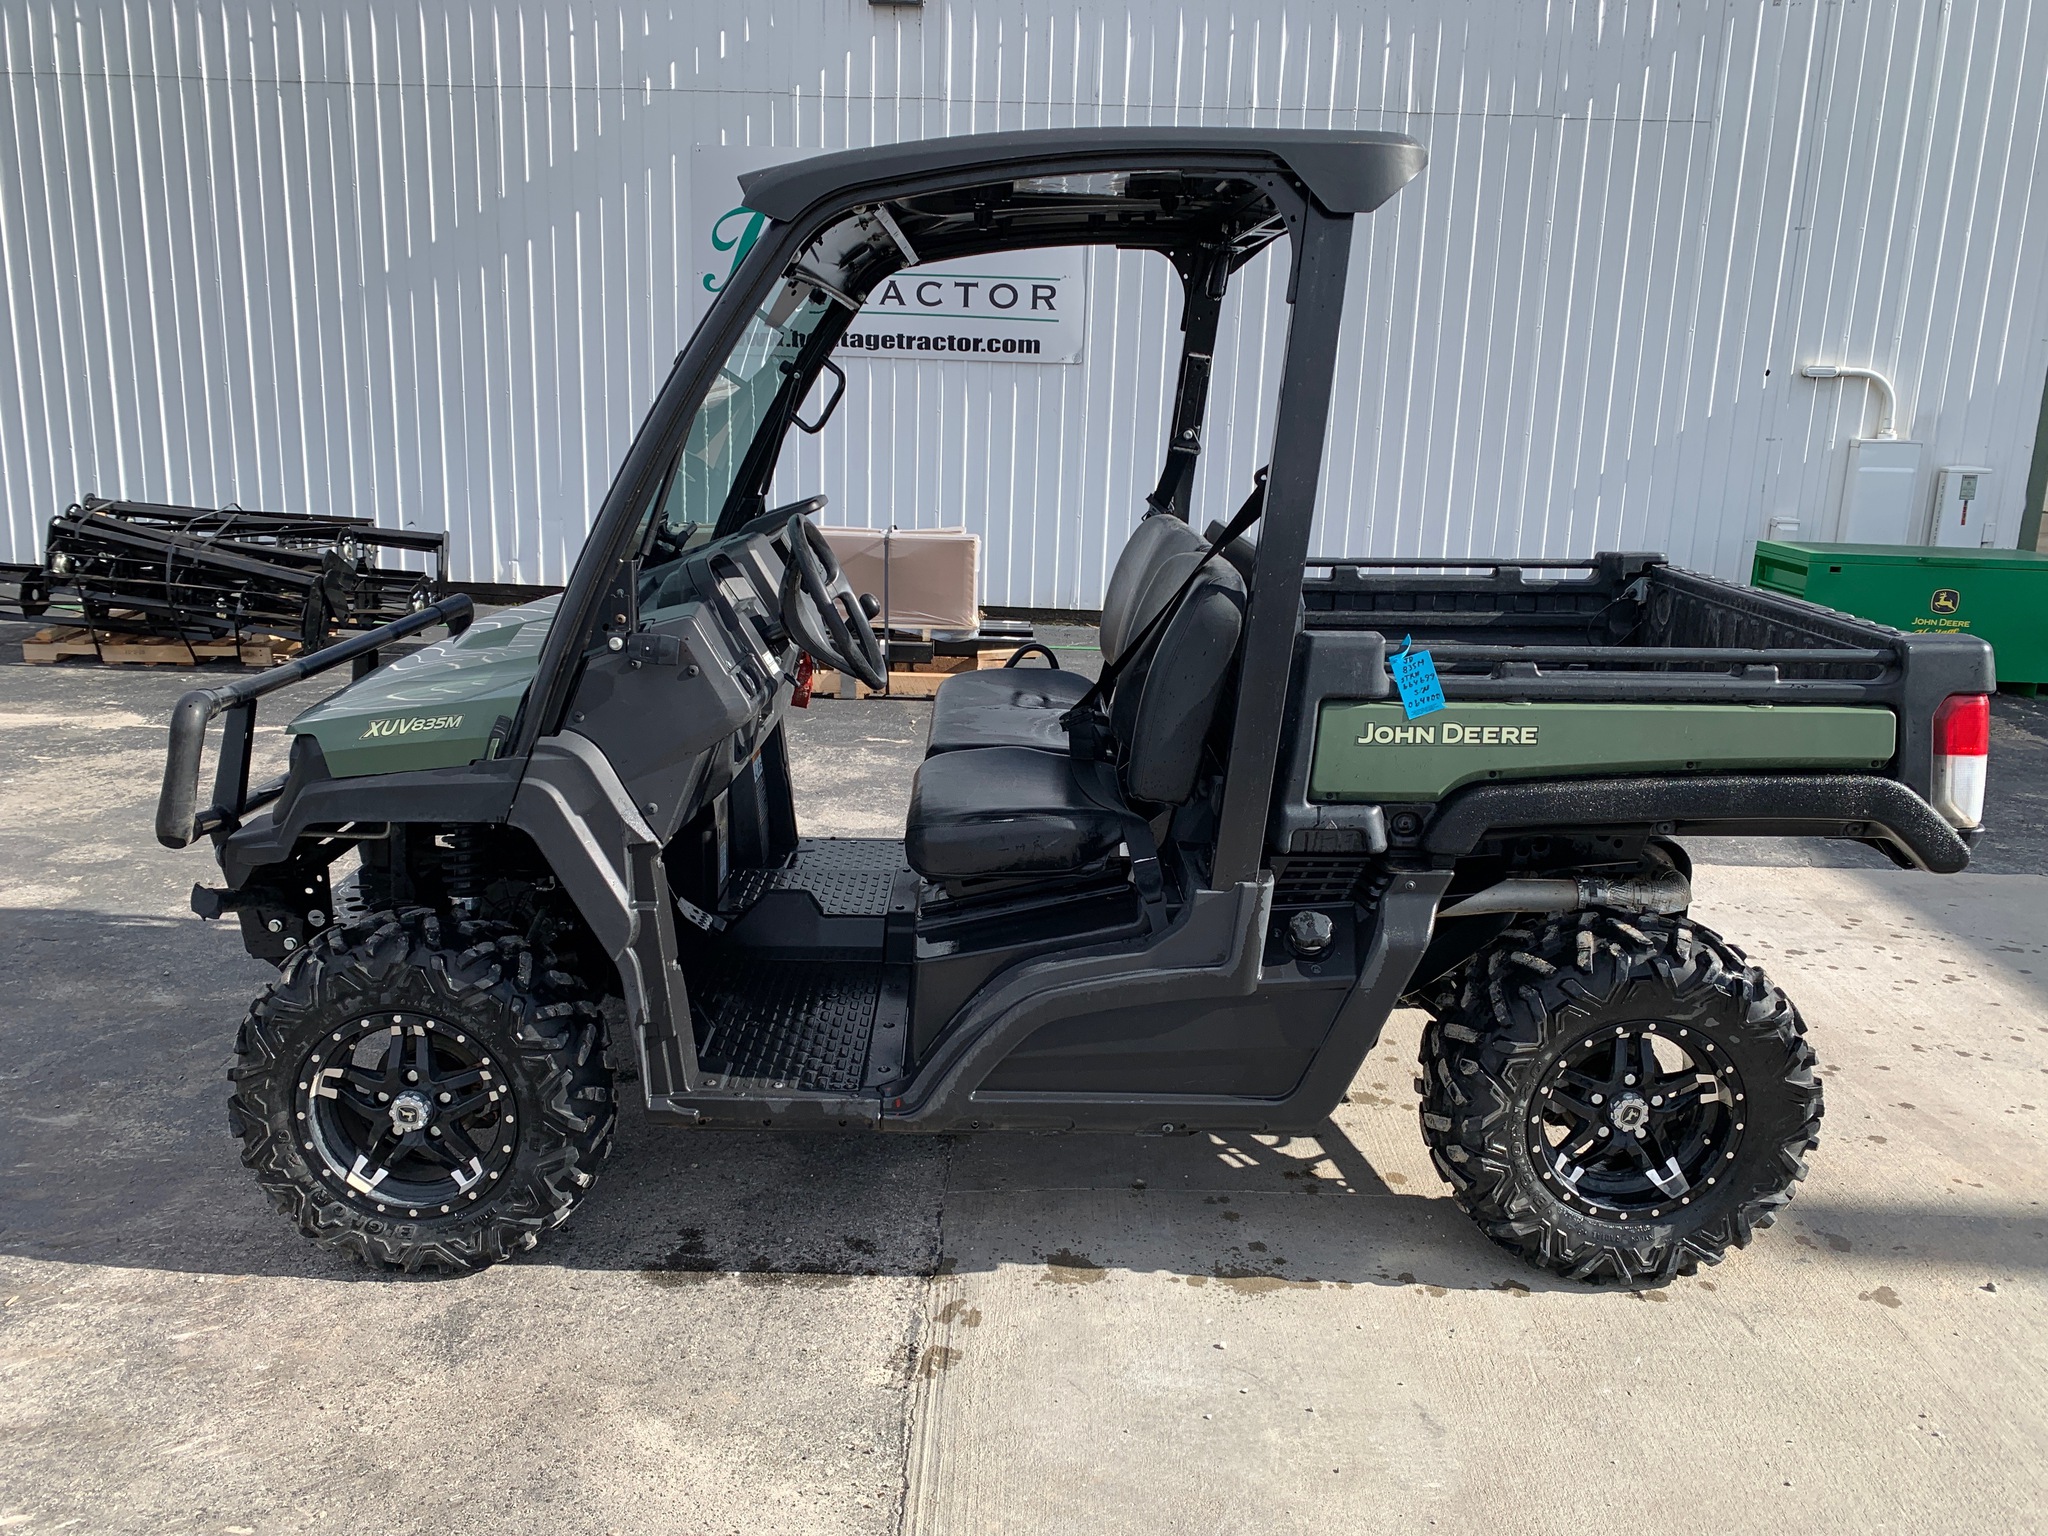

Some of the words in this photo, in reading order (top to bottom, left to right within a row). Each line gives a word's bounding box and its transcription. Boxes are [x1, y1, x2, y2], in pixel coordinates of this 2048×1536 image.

[857, 279, 1057, 311] ACTOR
[1911, 617, 1938, 626] JOHN
[1938, 618, 1970, 628] DEERE
[361, 714, 464, 739] XUV835M
[1357, 722, 1436, 745] JOHN
[1441, 722, 1539, 745] DEERE
